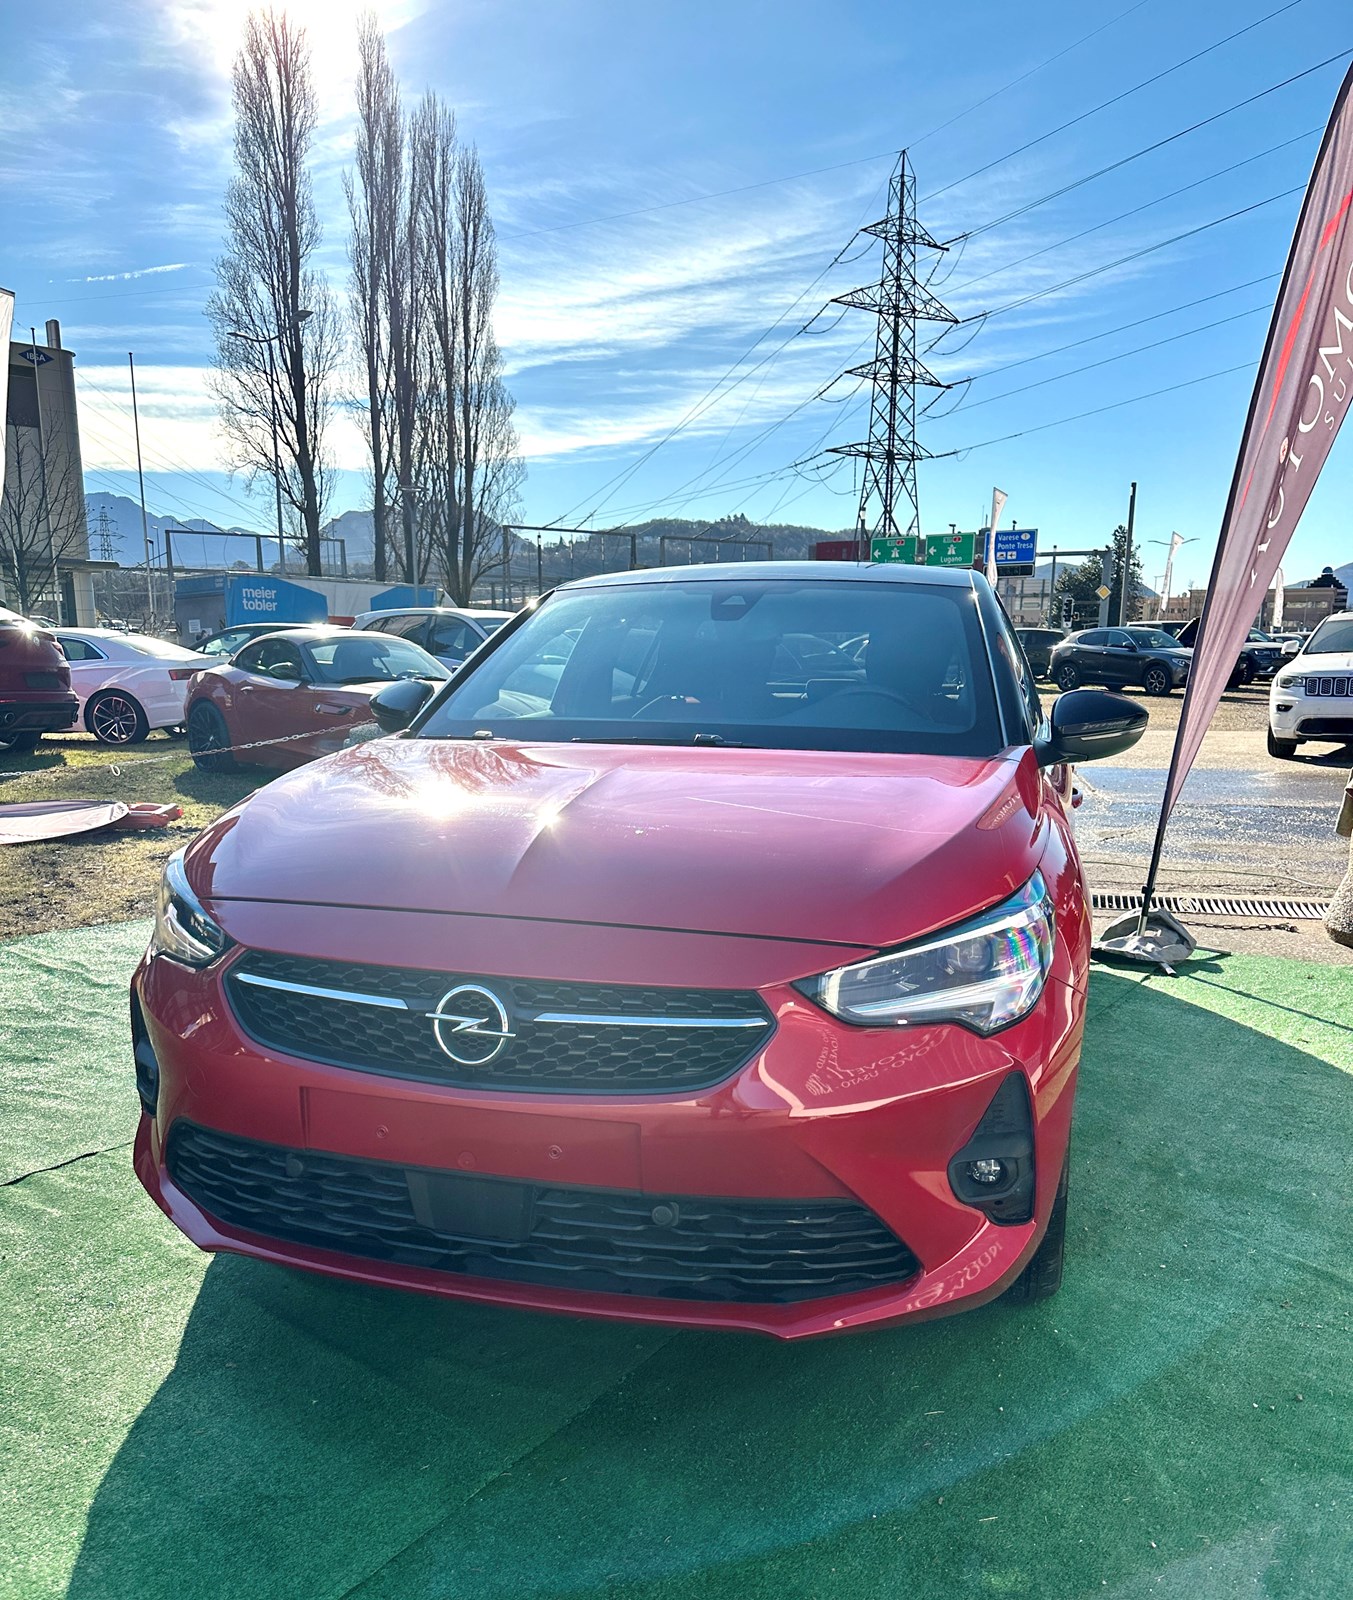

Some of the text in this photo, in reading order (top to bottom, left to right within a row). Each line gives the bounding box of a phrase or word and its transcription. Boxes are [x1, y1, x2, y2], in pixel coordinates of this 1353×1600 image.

[26, 352, 46, 362] IBSA
[940, 556, 962, 564] Lugano
[242, 586, 277, 598] meier
[242, 598, 278, 611] tobler
